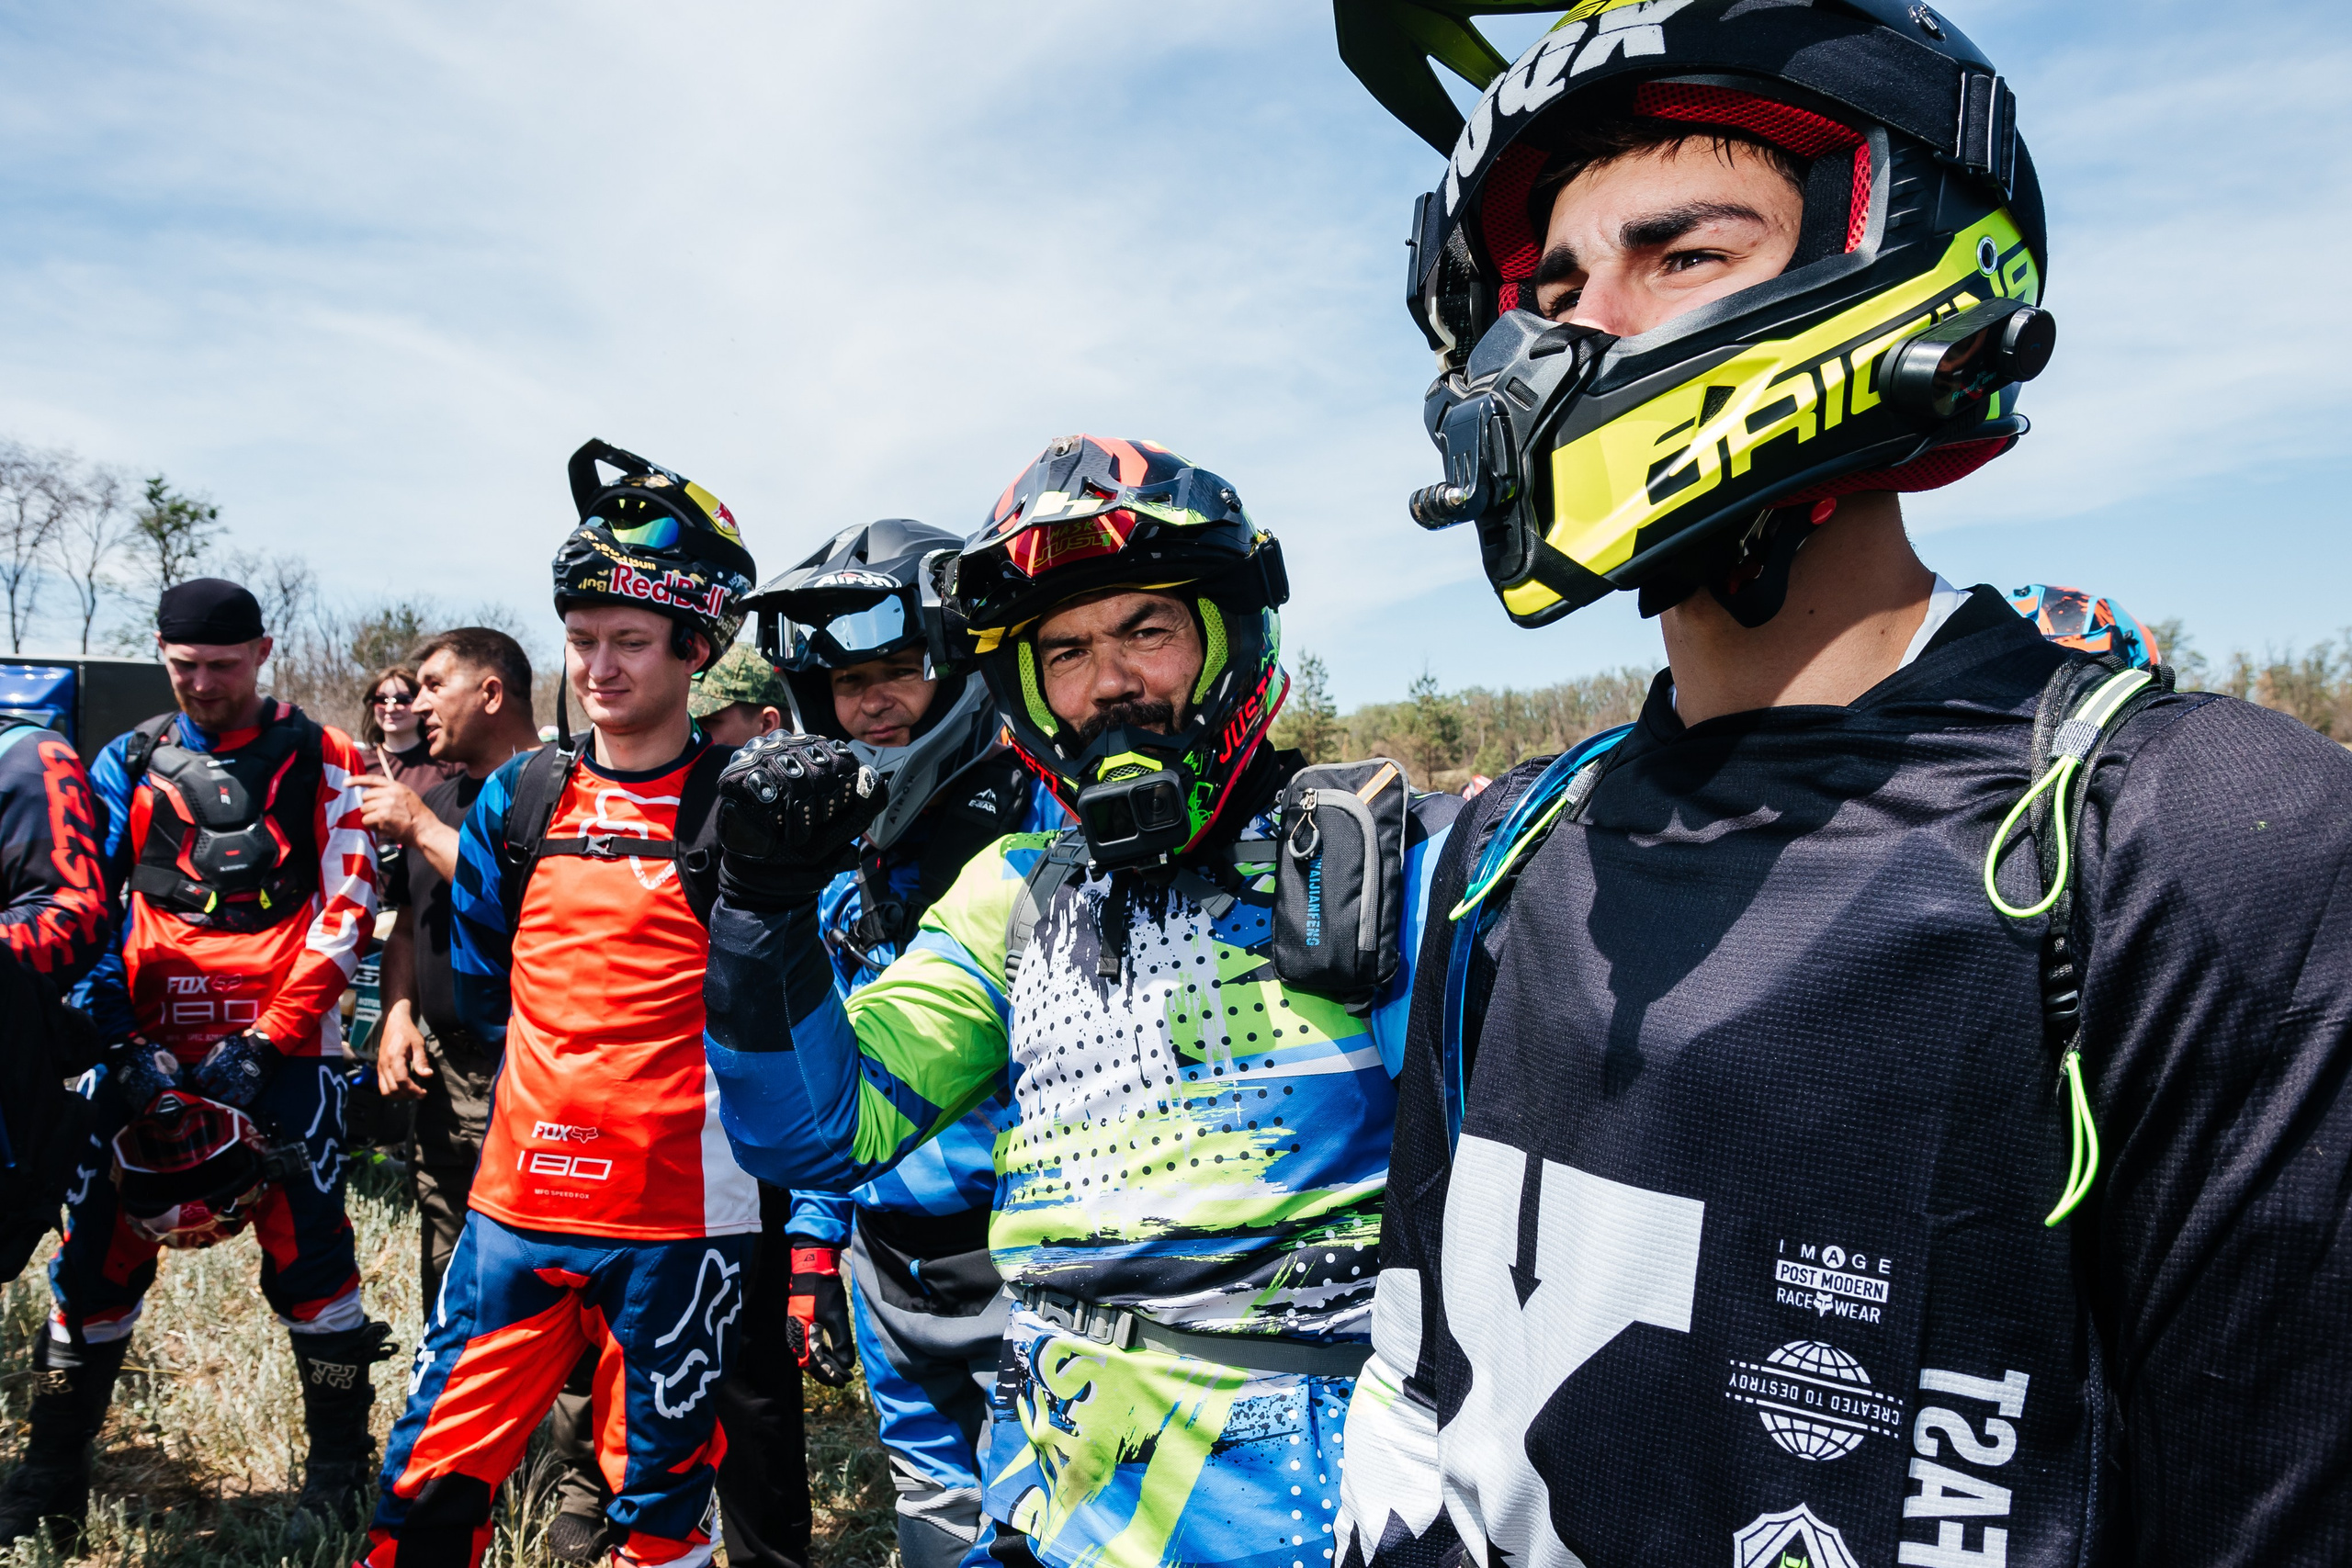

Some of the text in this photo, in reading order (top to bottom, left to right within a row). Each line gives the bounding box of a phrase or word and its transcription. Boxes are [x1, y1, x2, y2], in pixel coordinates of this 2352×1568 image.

[612, 563, 673, 603] Red
[814, 572, 893, 588] Airoh
[889, 775, 915, 825] AIROH
[167, 976, 210, 995] FOX
[531, 1120, 572, 1142] FOX
[1779, 1238, 1892, 1275] IMAGE
[1780, 1264, 1884, 1300] POST MODERN
[1776, 1287, 1881, 1325] RACE WEAR
[1728, 1372, 1901, 1427] CREATED TO DESTROY
